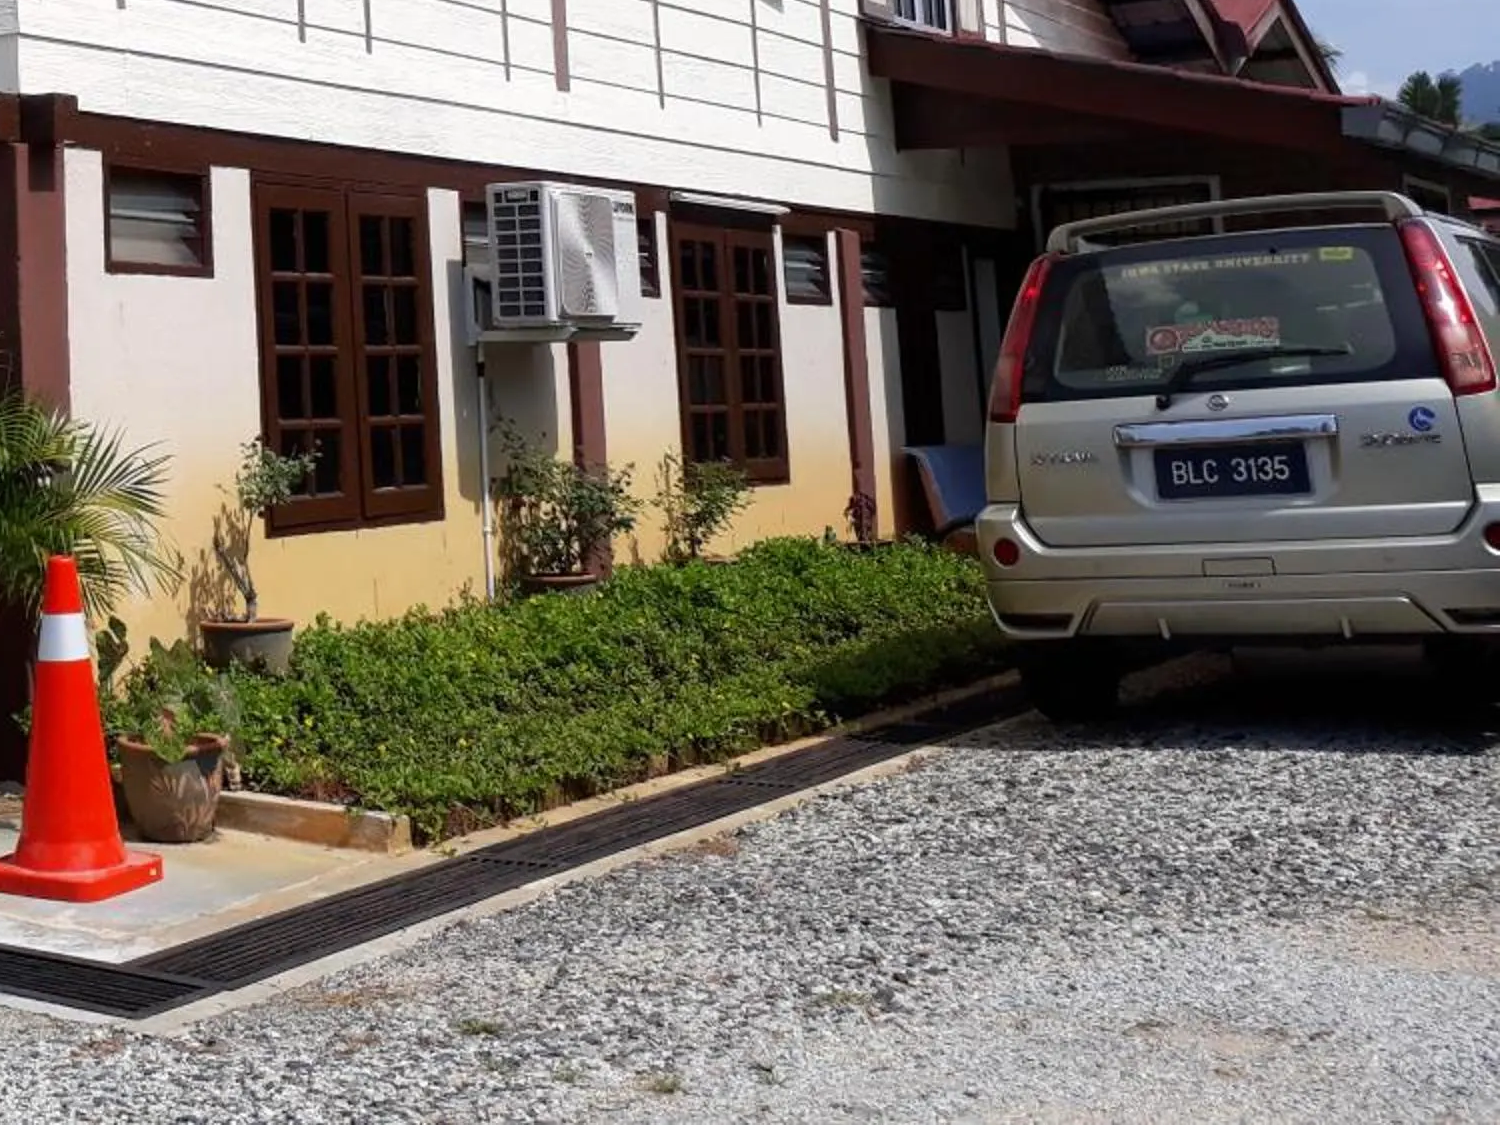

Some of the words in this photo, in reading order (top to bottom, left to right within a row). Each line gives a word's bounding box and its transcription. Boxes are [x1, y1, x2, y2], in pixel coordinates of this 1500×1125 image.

[1163, 260, 1209, 274] STATE
[1215, 253, 1309, 269] UNIVERSITY
[1171, 458, 1220, 485] BLC
[1230, 455, 1290, 482] 3135
